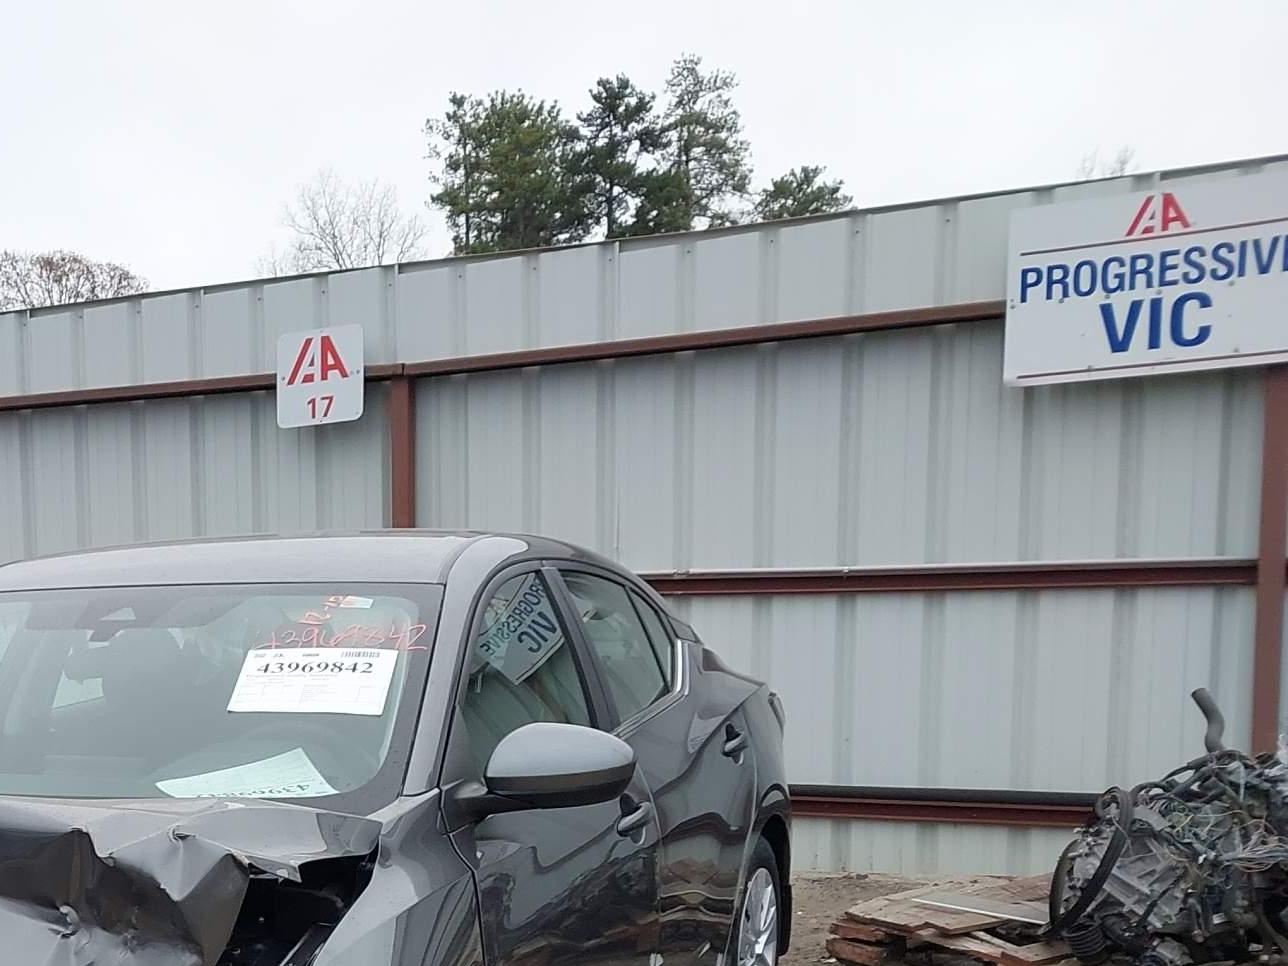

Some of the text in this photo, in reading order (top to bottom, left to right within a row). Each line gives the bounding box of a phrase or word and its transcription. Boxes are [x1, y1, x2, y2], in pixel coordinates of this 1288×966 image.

[1100, 291, 1213, 353] VIC
[307, 395, 334, 419] 17
[256, 661, 374, 675] 43969842
